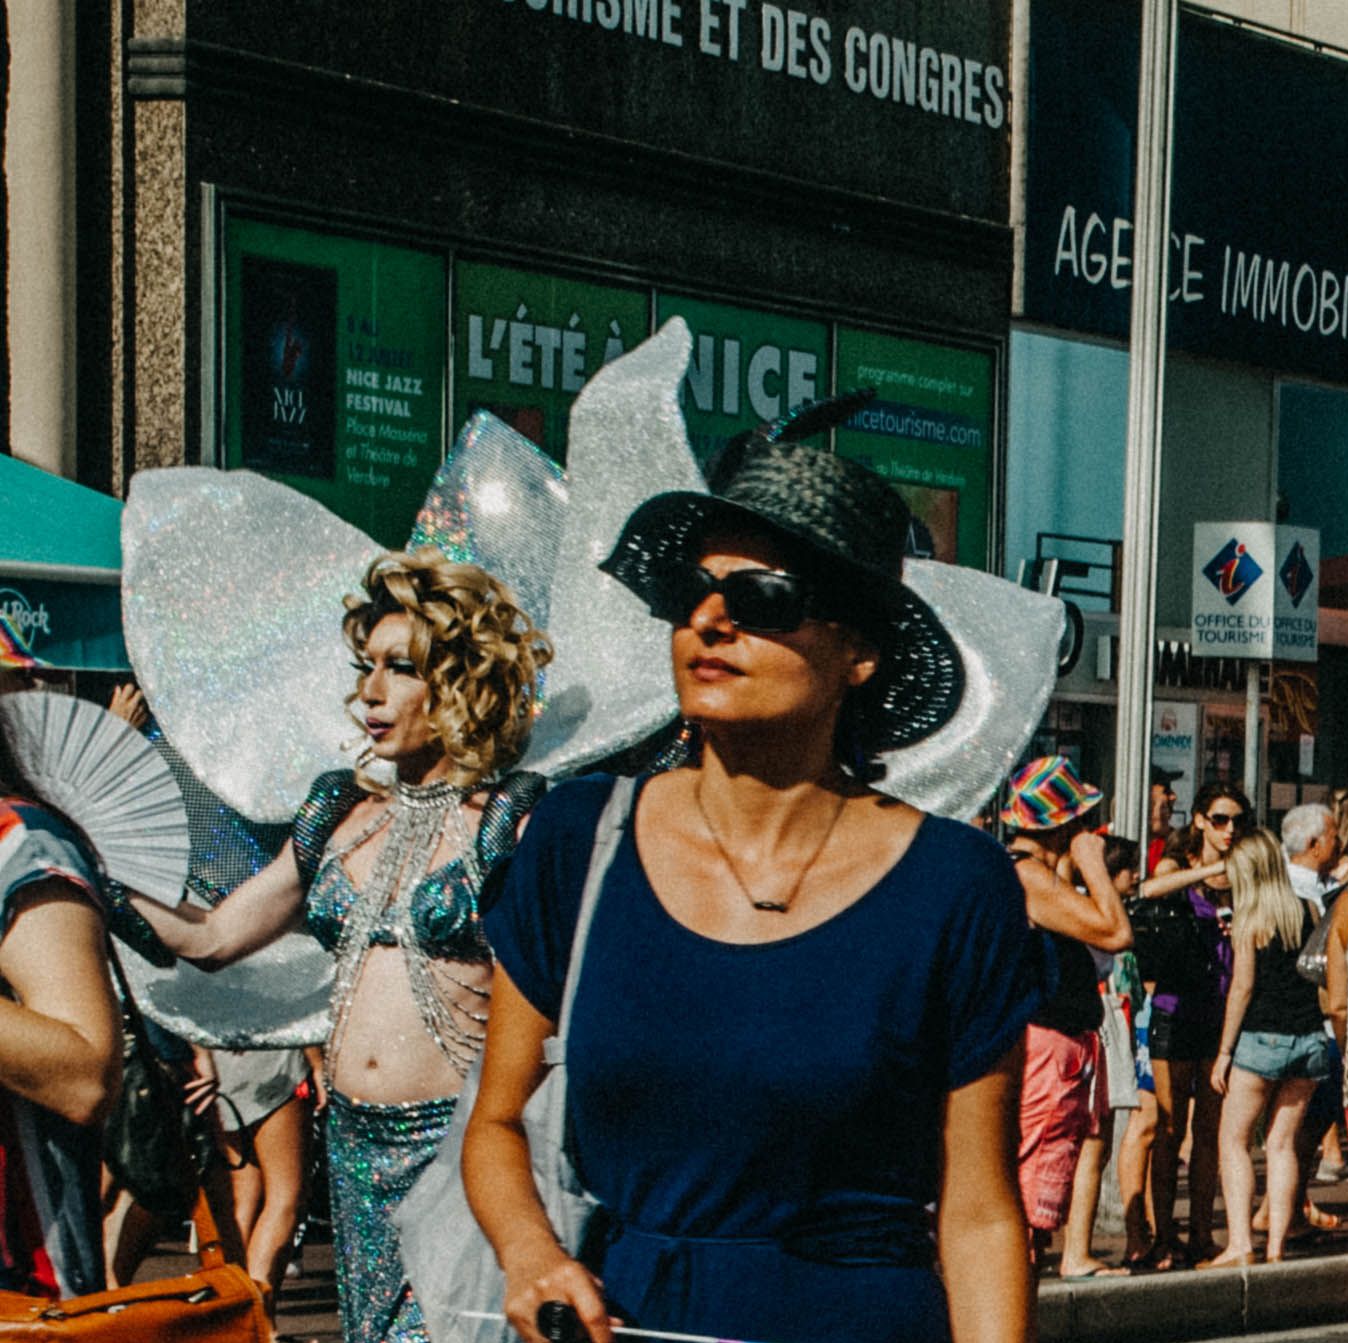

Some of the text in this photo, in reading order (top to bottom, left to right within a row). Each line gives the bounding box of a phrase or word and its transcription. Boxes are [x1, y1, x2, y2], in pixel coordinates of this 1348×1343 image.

[700, 0, 746, 60] ET
[761, 4, 831, 84] DES
[844, 27, 1003, 128] CONGRES
[1055, 205, 1204, 302] AGEE
[467, 303, 588, 393] L'ÉTÉ
[346, 368, 423, 395] NICE JAZZ
[857, 366, 915, 385] programme
[346, 394, 412, 418] FESTIVAL
[346, 417, 376, 438] Place
[1194, 614, 1271, 629] OFFICE DU
[1198, 630, 1266, 644] TOURISME
